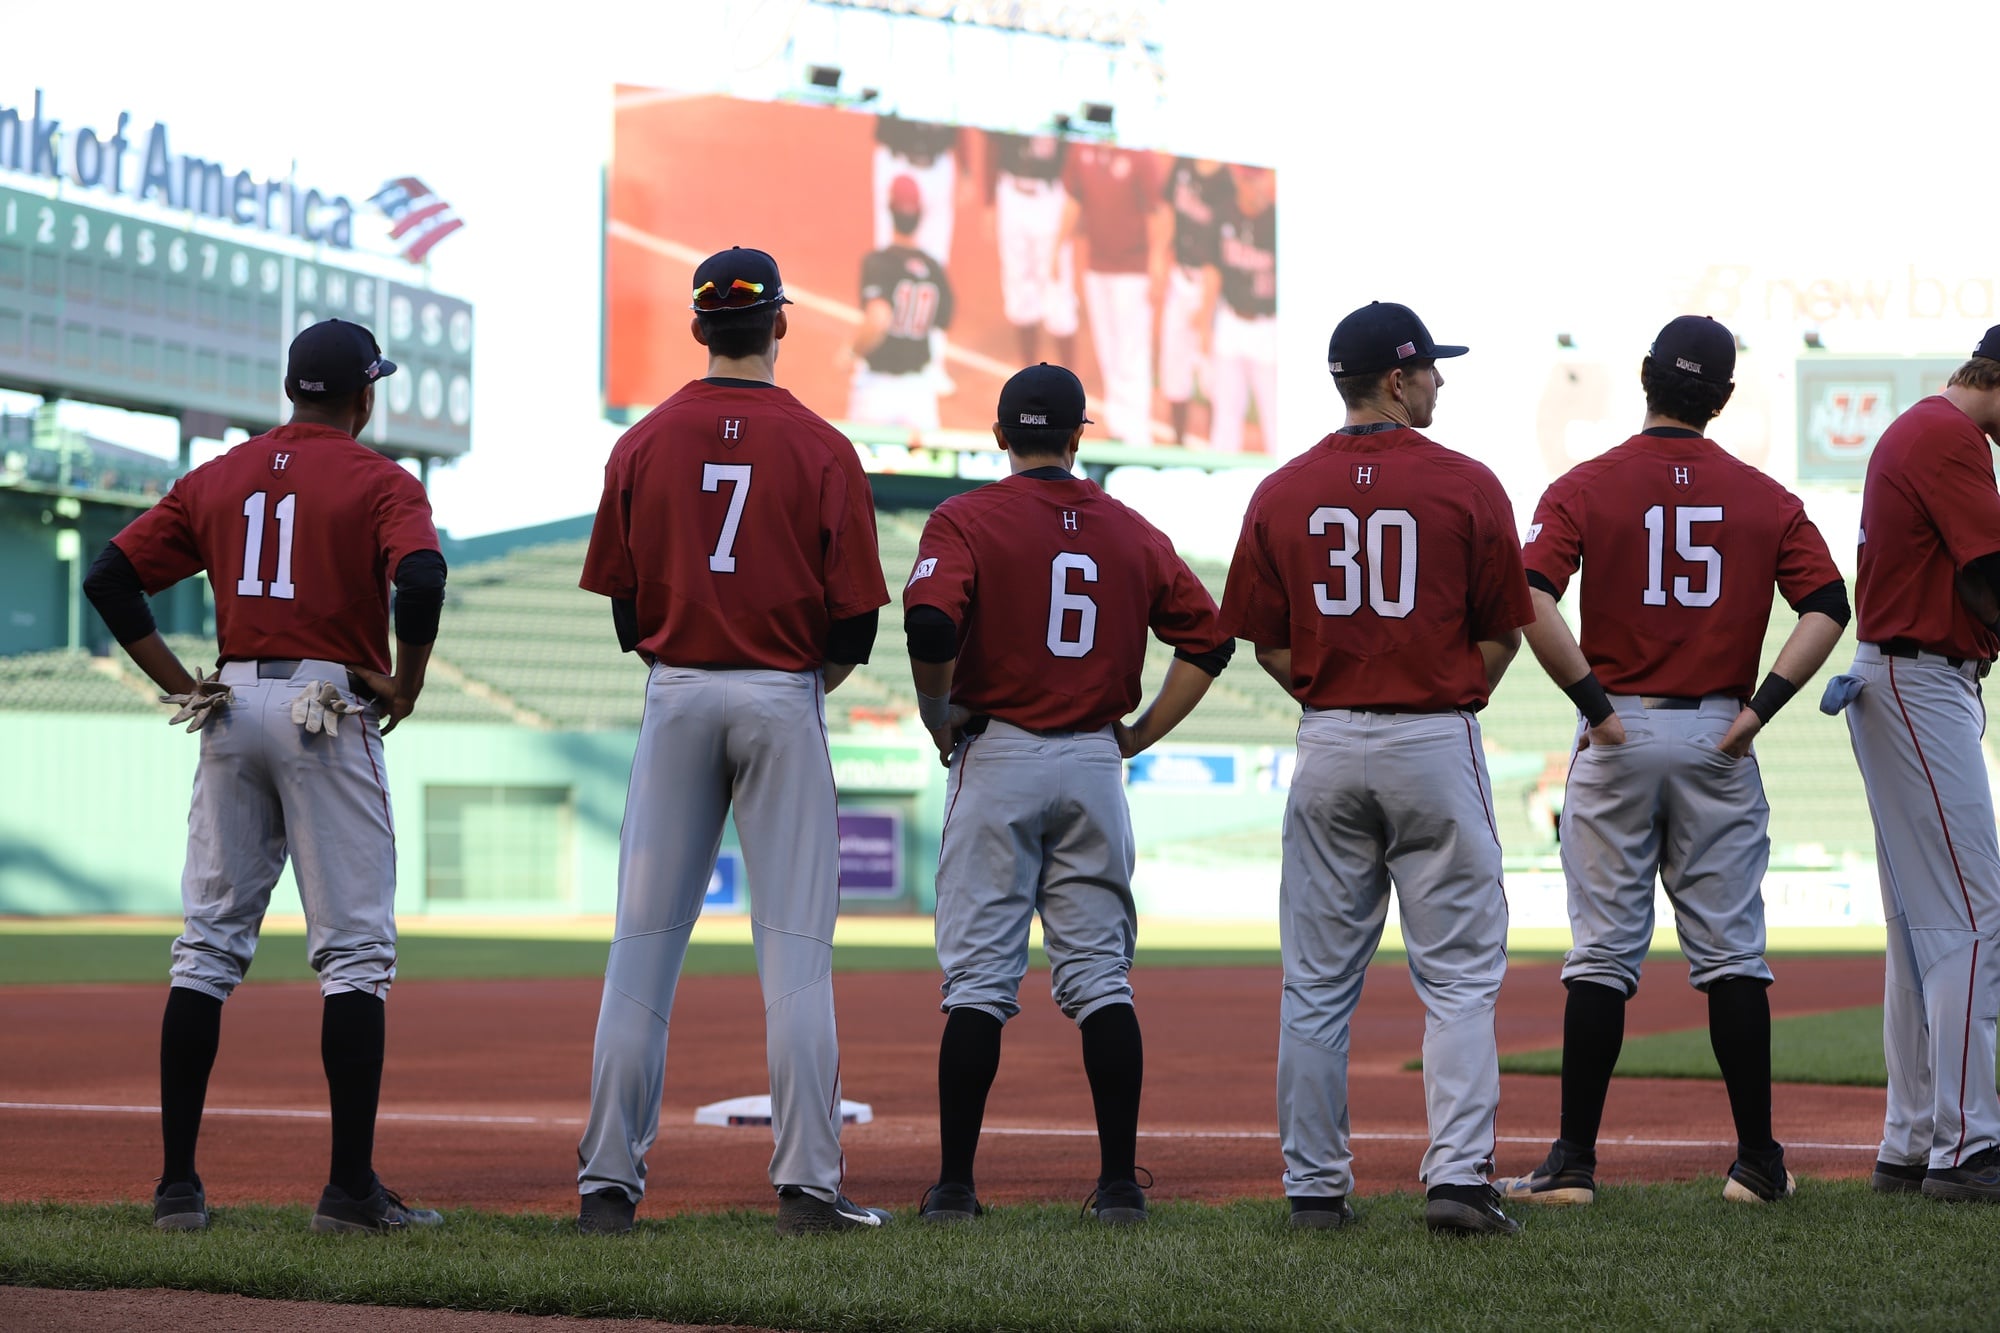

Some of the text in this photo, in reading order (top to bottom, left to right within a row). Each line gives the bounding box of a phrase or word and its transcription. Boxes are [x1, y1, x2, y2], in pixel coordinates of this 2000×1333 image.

[75, 111, 128, 193] of
[139, 120, 353, 250] America
[6, 197, 18, 235] 1
[37, 206, 56, 243] 2
[71, 213, 90, 250] 3
[104, 222, 123, 259] 4
[137, 229, 156, 266] 5
[168, 236, 188, 273] 6
[200, 243, 218, 279] 7
[230, 251, 250, 287] 8
[260, 258, 280, 294] 9
[299, 265, 318, 300] R
[354, 278, 374, 315] E
[1764, 278, 1892, 320] new
[421, 302, 442, 346] S
[1676, 357, 1702, 374] CRIMSON
[722, 419, 741, 440] H
[1020, 413, 1048, 425] CRIMSON
[272, 452, 290, 470] H
[1356, 466, 1373, 485] H
[1674, 467, 1689, 485] H
[701, 462, 752, 573] 7
[1062, 510, 1078, 531] H
[237, 491, 296, 600] 11
[1308, 505, 1418, 618] 30
[1642, 505, 1724, 608] 15
[1046, 551, 1099, 658] 6
